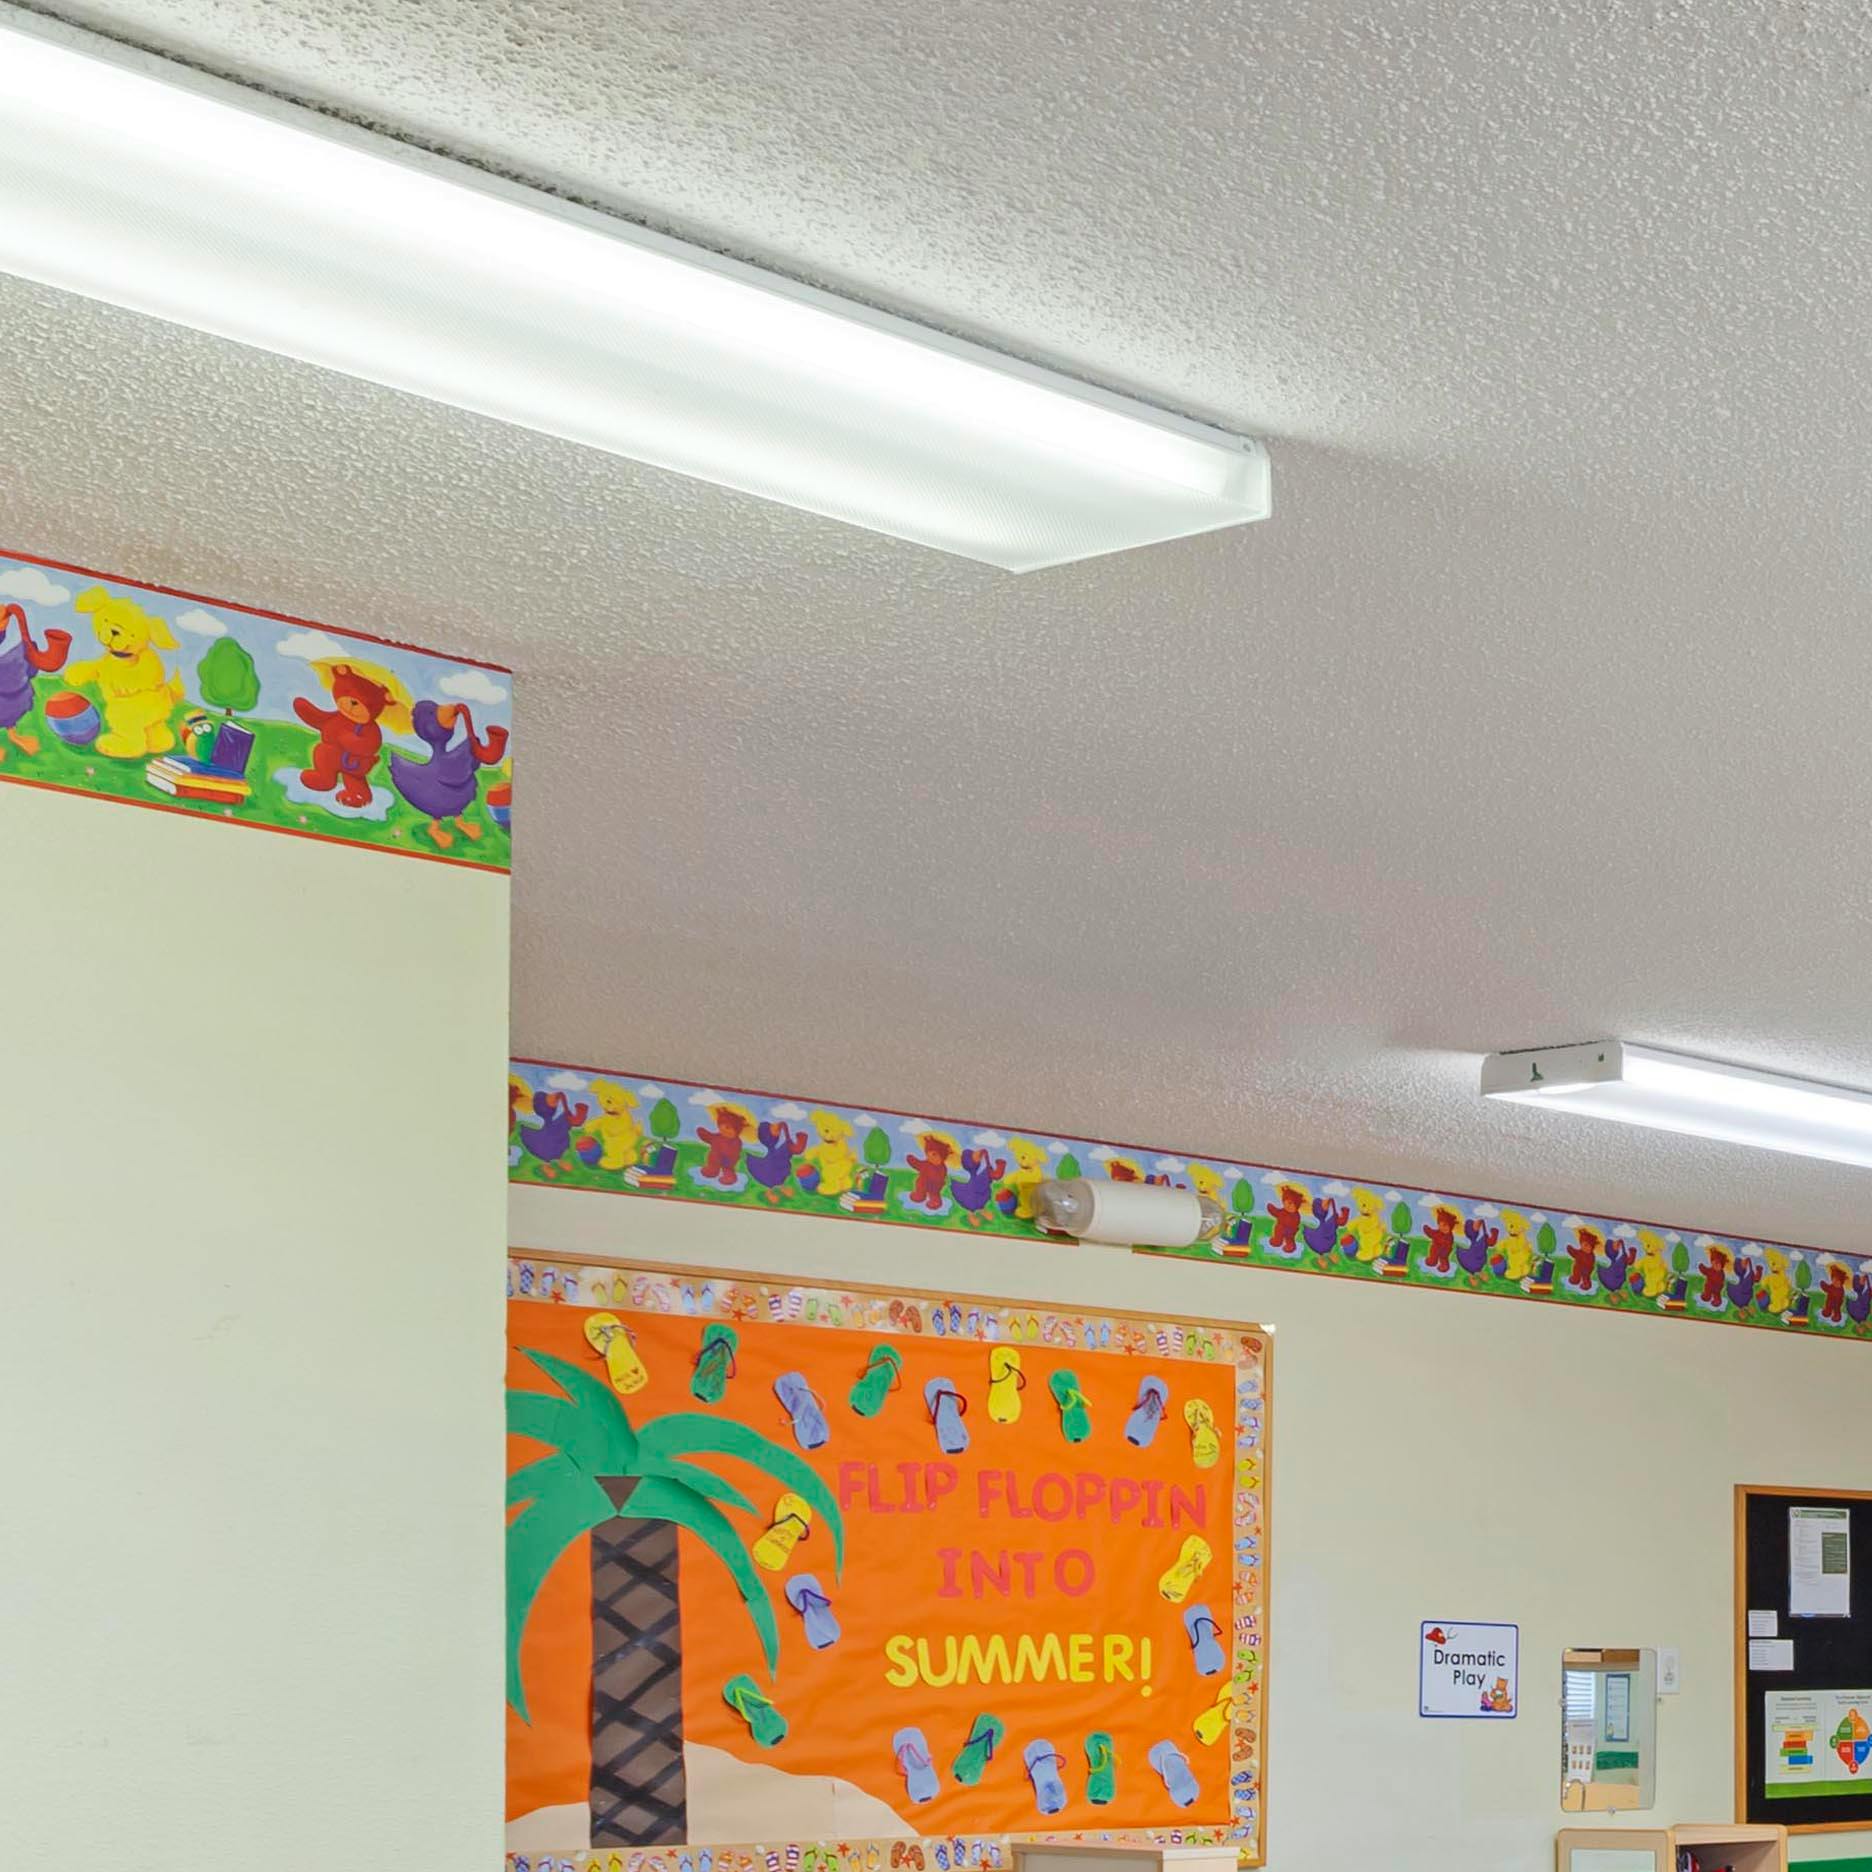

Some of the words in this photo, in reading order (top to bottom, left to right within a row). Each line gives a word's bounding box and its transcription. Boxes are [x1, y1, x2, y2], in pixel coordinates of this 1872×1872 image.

[837, 1459, 959, 1515] FLIP
[976, 1467, 1208, 1530] FLOPPIN
[935, 1547, 1096, 1600] INTO
[884, 1632, 1153, 1698] SUMMER!
[1433, 1648, 1507, 1667] Dramatic
[1453, 1669, 1486, 1690] Play
